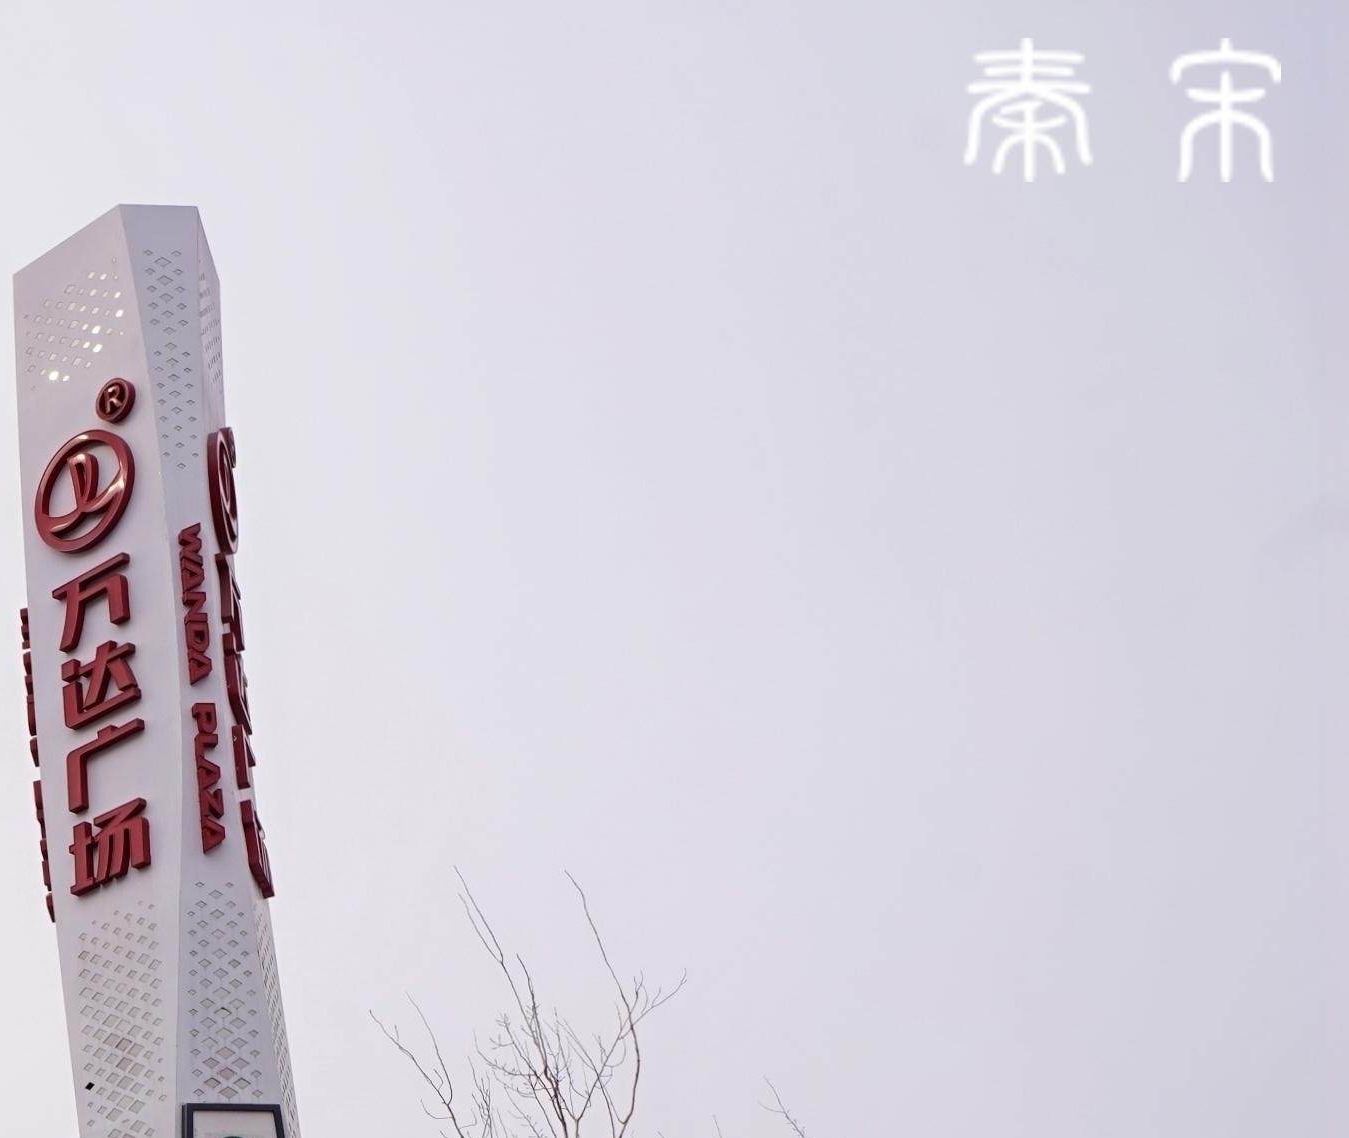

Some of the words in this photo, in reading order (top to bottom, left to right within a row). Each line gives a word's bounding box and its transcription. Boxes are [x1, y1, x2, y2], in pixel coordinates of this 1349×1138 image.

[177, 522, 211, 687] WANDA
[52, 552, 151, 899] 万达广场
[191, 702, 228, 854] PLAZA
